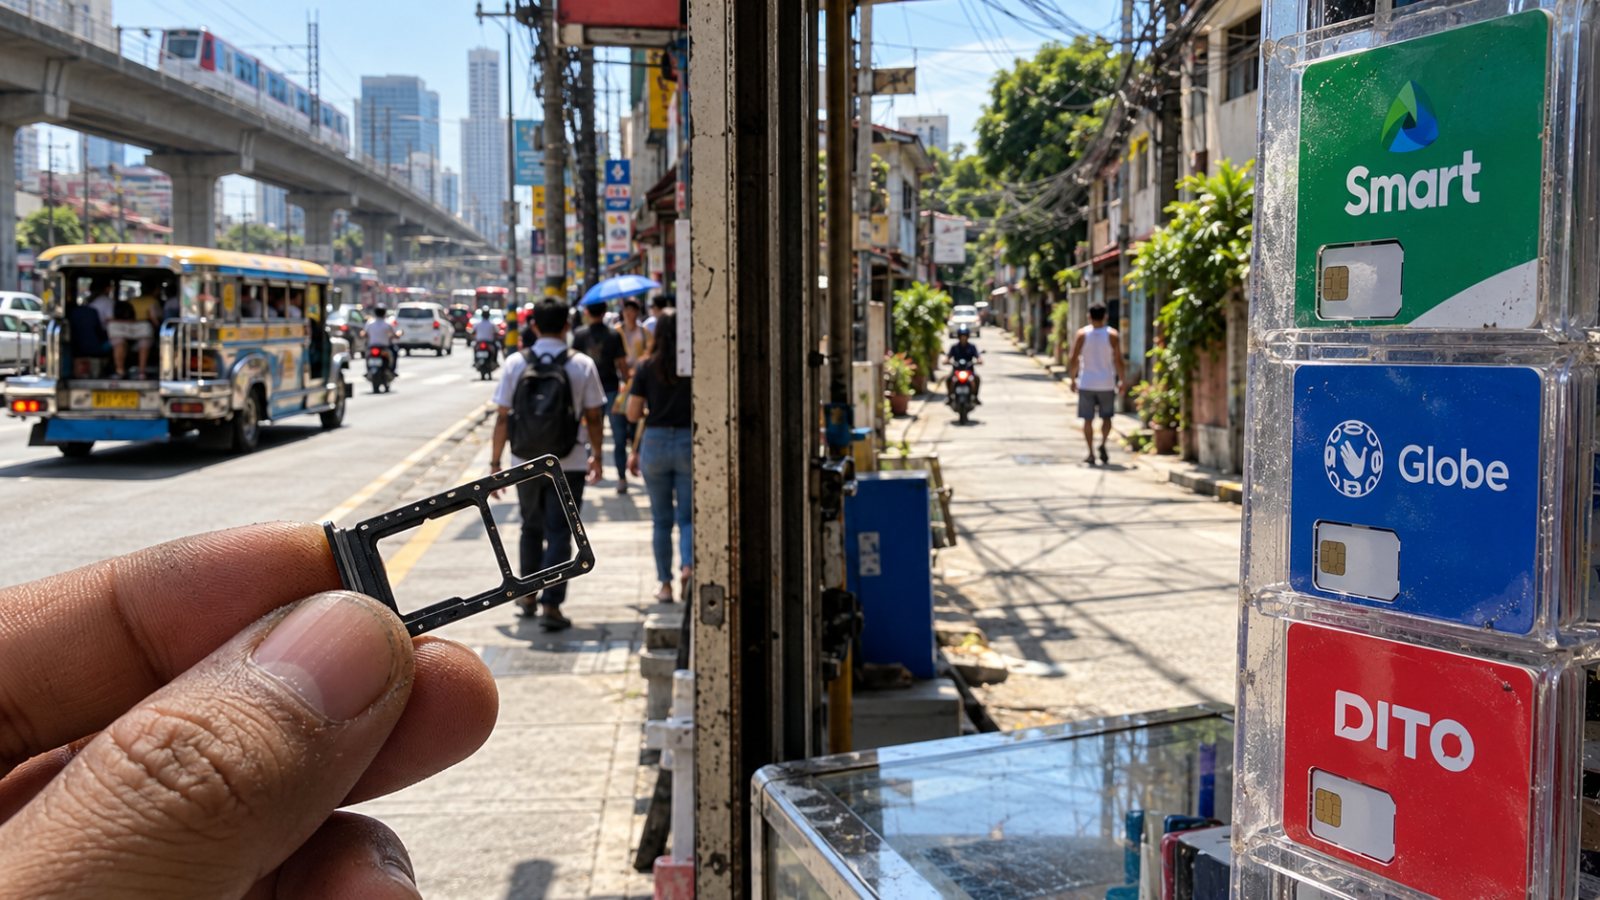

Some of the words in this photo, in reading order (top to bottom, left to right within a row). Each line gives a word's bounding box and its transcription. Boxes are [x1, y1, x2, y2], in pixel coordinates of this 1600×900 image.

[1344, 149, 1482, 216] Smart
[1398, 444, 1509, 492] Globe
[1334, 689, 1475, 772] DITO
